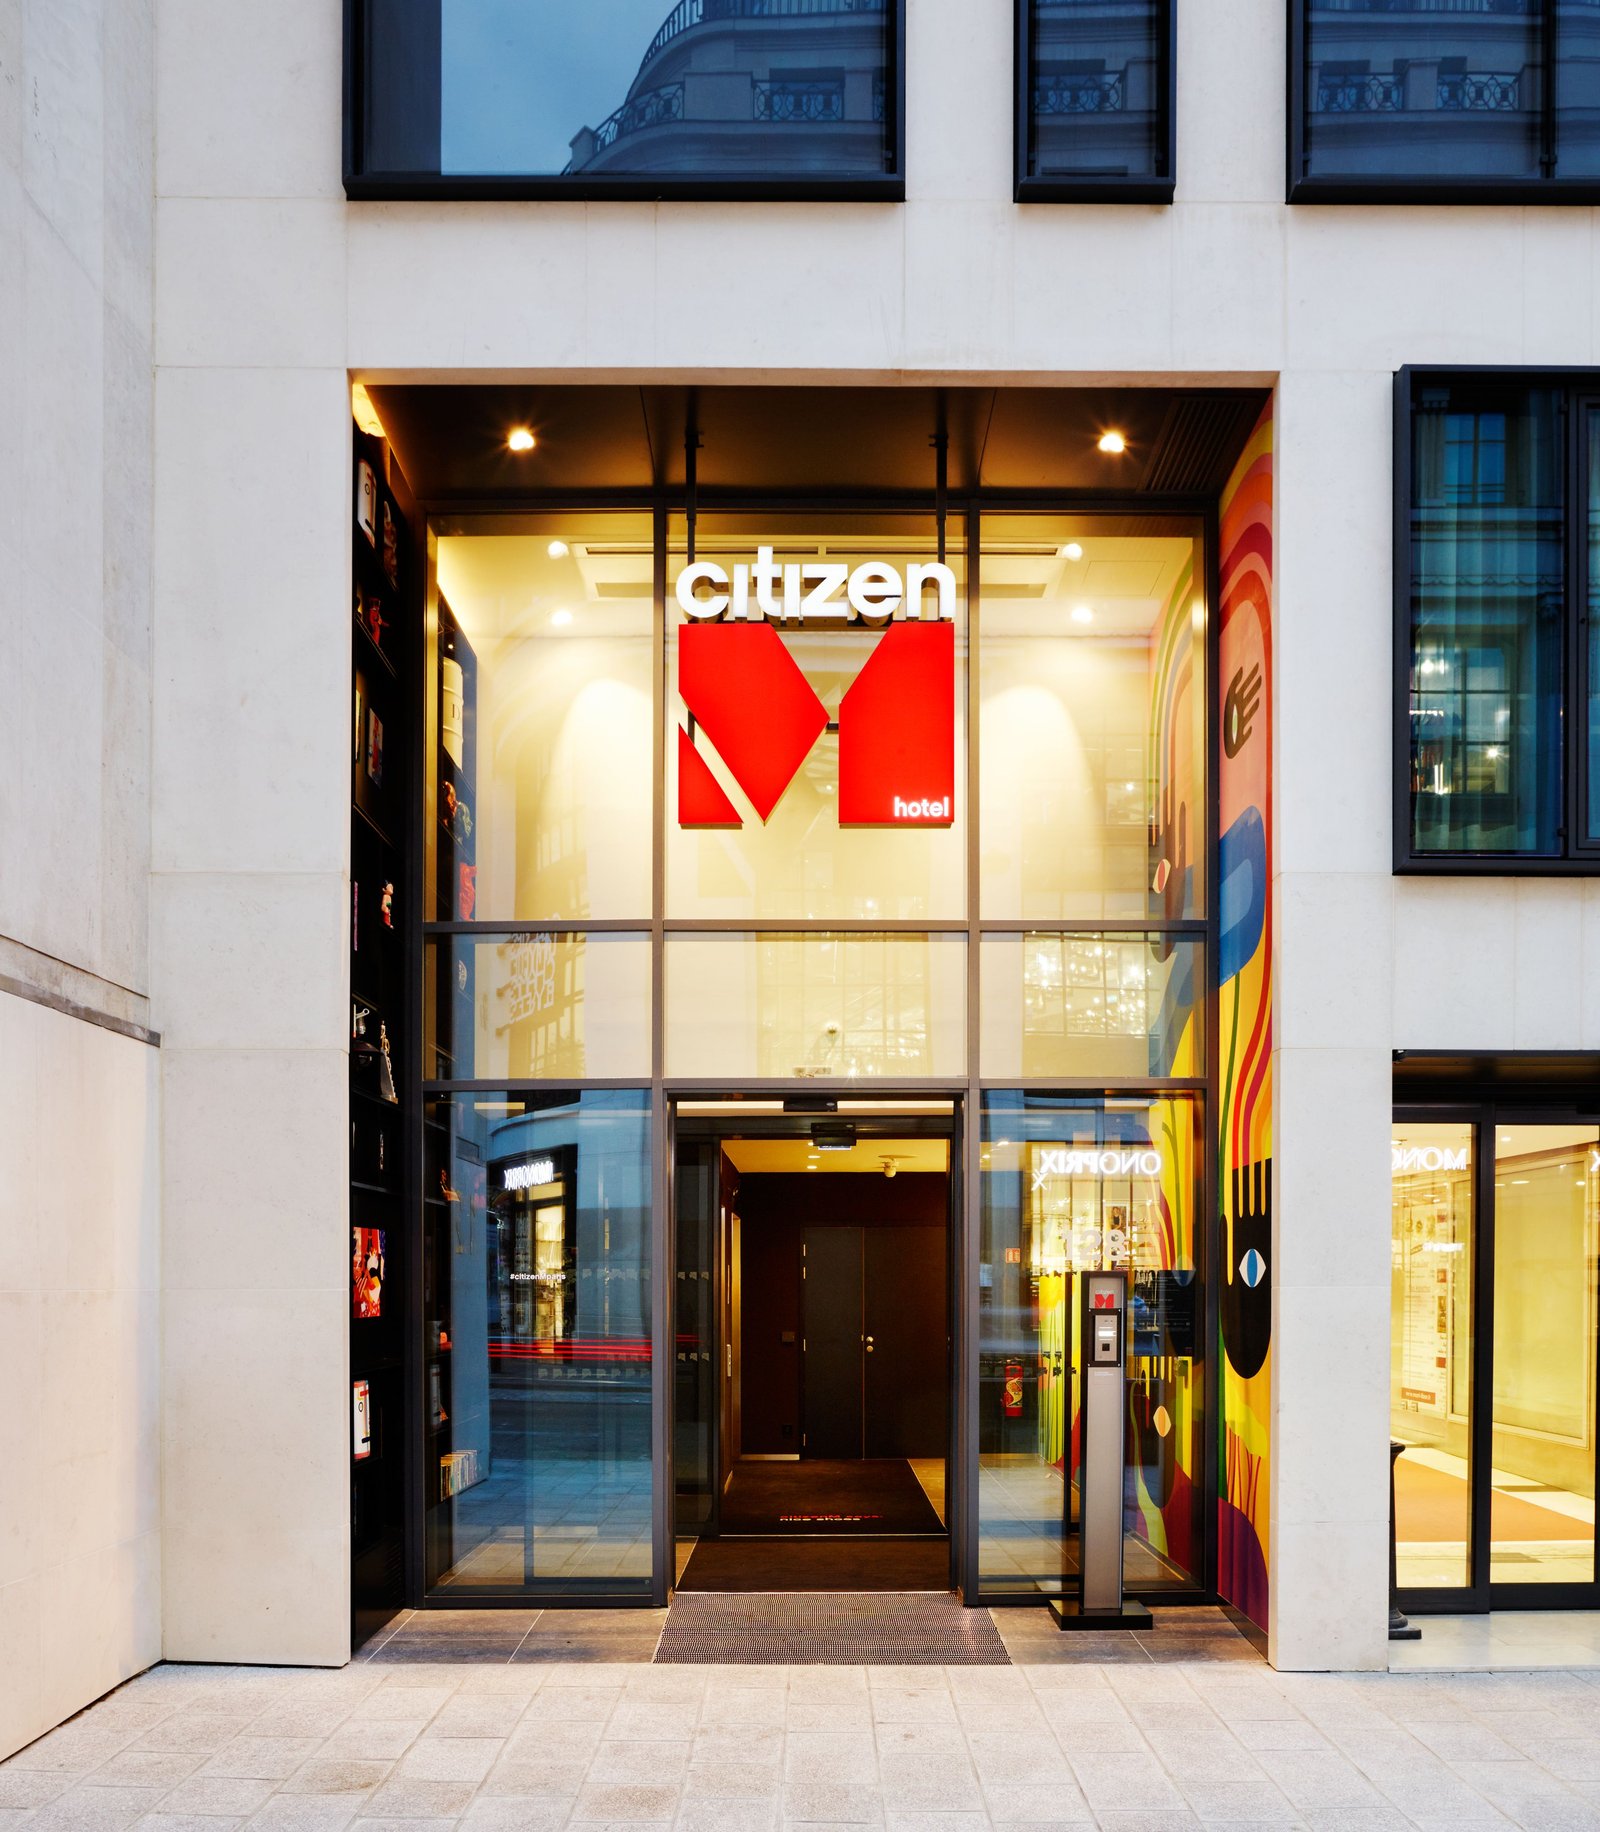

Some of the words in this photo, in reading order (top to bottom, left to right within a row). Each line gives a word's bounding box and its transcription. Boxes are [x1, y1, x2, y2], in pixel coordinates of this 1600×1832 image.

[676, 545, 956, 618] citizen
[678, 622, 954, 824] M
[894, 796, 949, 817] hotel
